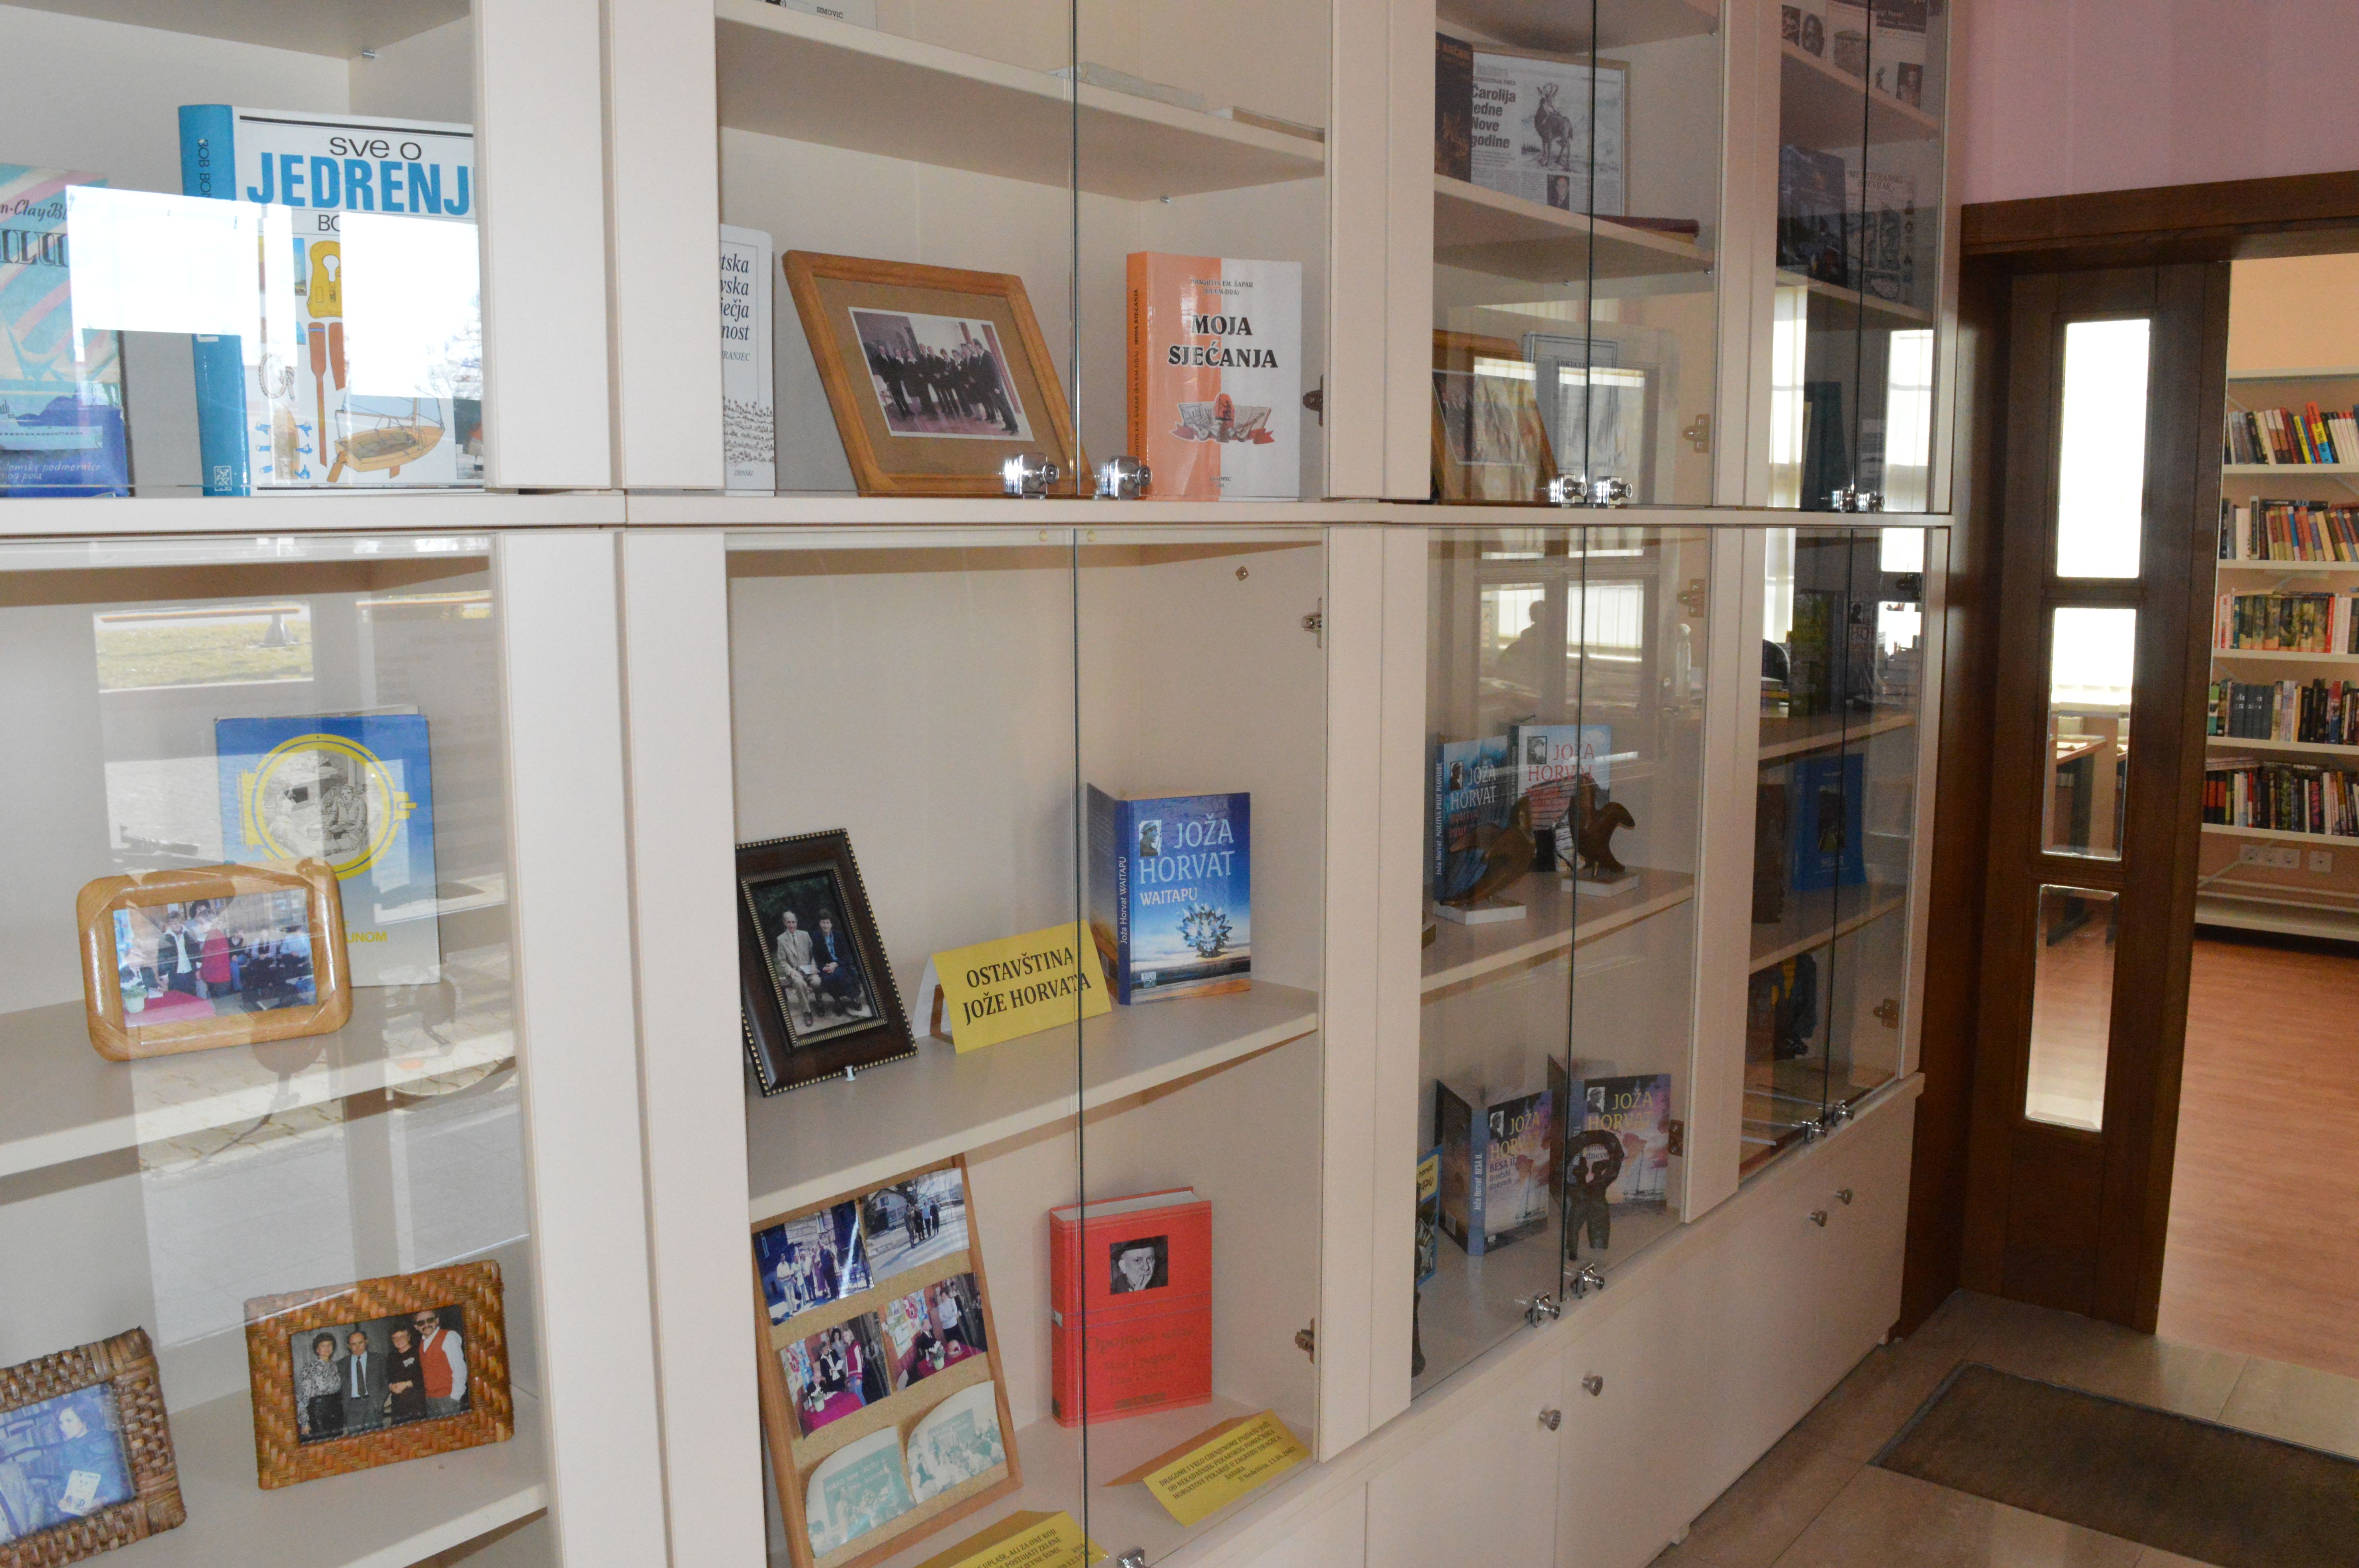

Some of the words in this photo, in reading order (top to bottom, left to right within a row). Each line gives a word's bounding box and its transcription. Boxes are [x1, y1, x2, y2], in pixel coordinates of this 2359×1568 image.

[816, 7, 843, 18] SIMOVIĆ
[1473, 103, 1503, 116] edne
[247, 152, 475, 216] JEDRENJ
[1191, 314, 1253, 336] MOJA
[1168, 340, 1279, 368] SJEĆANJA
[1468, 760, 1496, 786] JOŽA
[1450, 785, 1497, 810] HORVAT
[1174, 812, 1235, 849] JOŽA
[1119, 857, 1127, 895] WAITAPU
[1139, 850, 1236, 884] HORVAT
[1140, 887, 1198, 906] WAITAPU
[966, 948, 1073, 987] OSTAVŠTINA
[963, 992, 1007, 1025] JOŽE
[1010, 972, 1090, 1007] HORVATA
[1612, 1088, 1653, 1110] JOŽA
[1510, 1109, 1540, 1135] JOŽA
[1588, 1111, 1653, 1131] HORVAT
[1489, 1160, 1508, 1173] BESA
[1489, 1178, 1513, 1191] dnevnik
[1213, 1447, 1245, 1466] PEKARSKOG
[1159, 1468, 1186, 1486] DRAGOME
[1189, 1458, 1205, 1469] VRLO
[1173, 1479, 1205, 1499] HORVATOVE
[1205, 1464, 1230, 1481] PEKARIJE
[1235, 1448, 1258, 1464] ZAGREBU
[1005, 1548, 1038, 1568] POSTOJATI
[1039, 1537, 1062, 1551] ZELENE
[1009, 1547, 1020, 1556] ALI
[1029, 1535, 1041, 1545] ONE
[1041, 1528, 1056, 1539] KOJI
